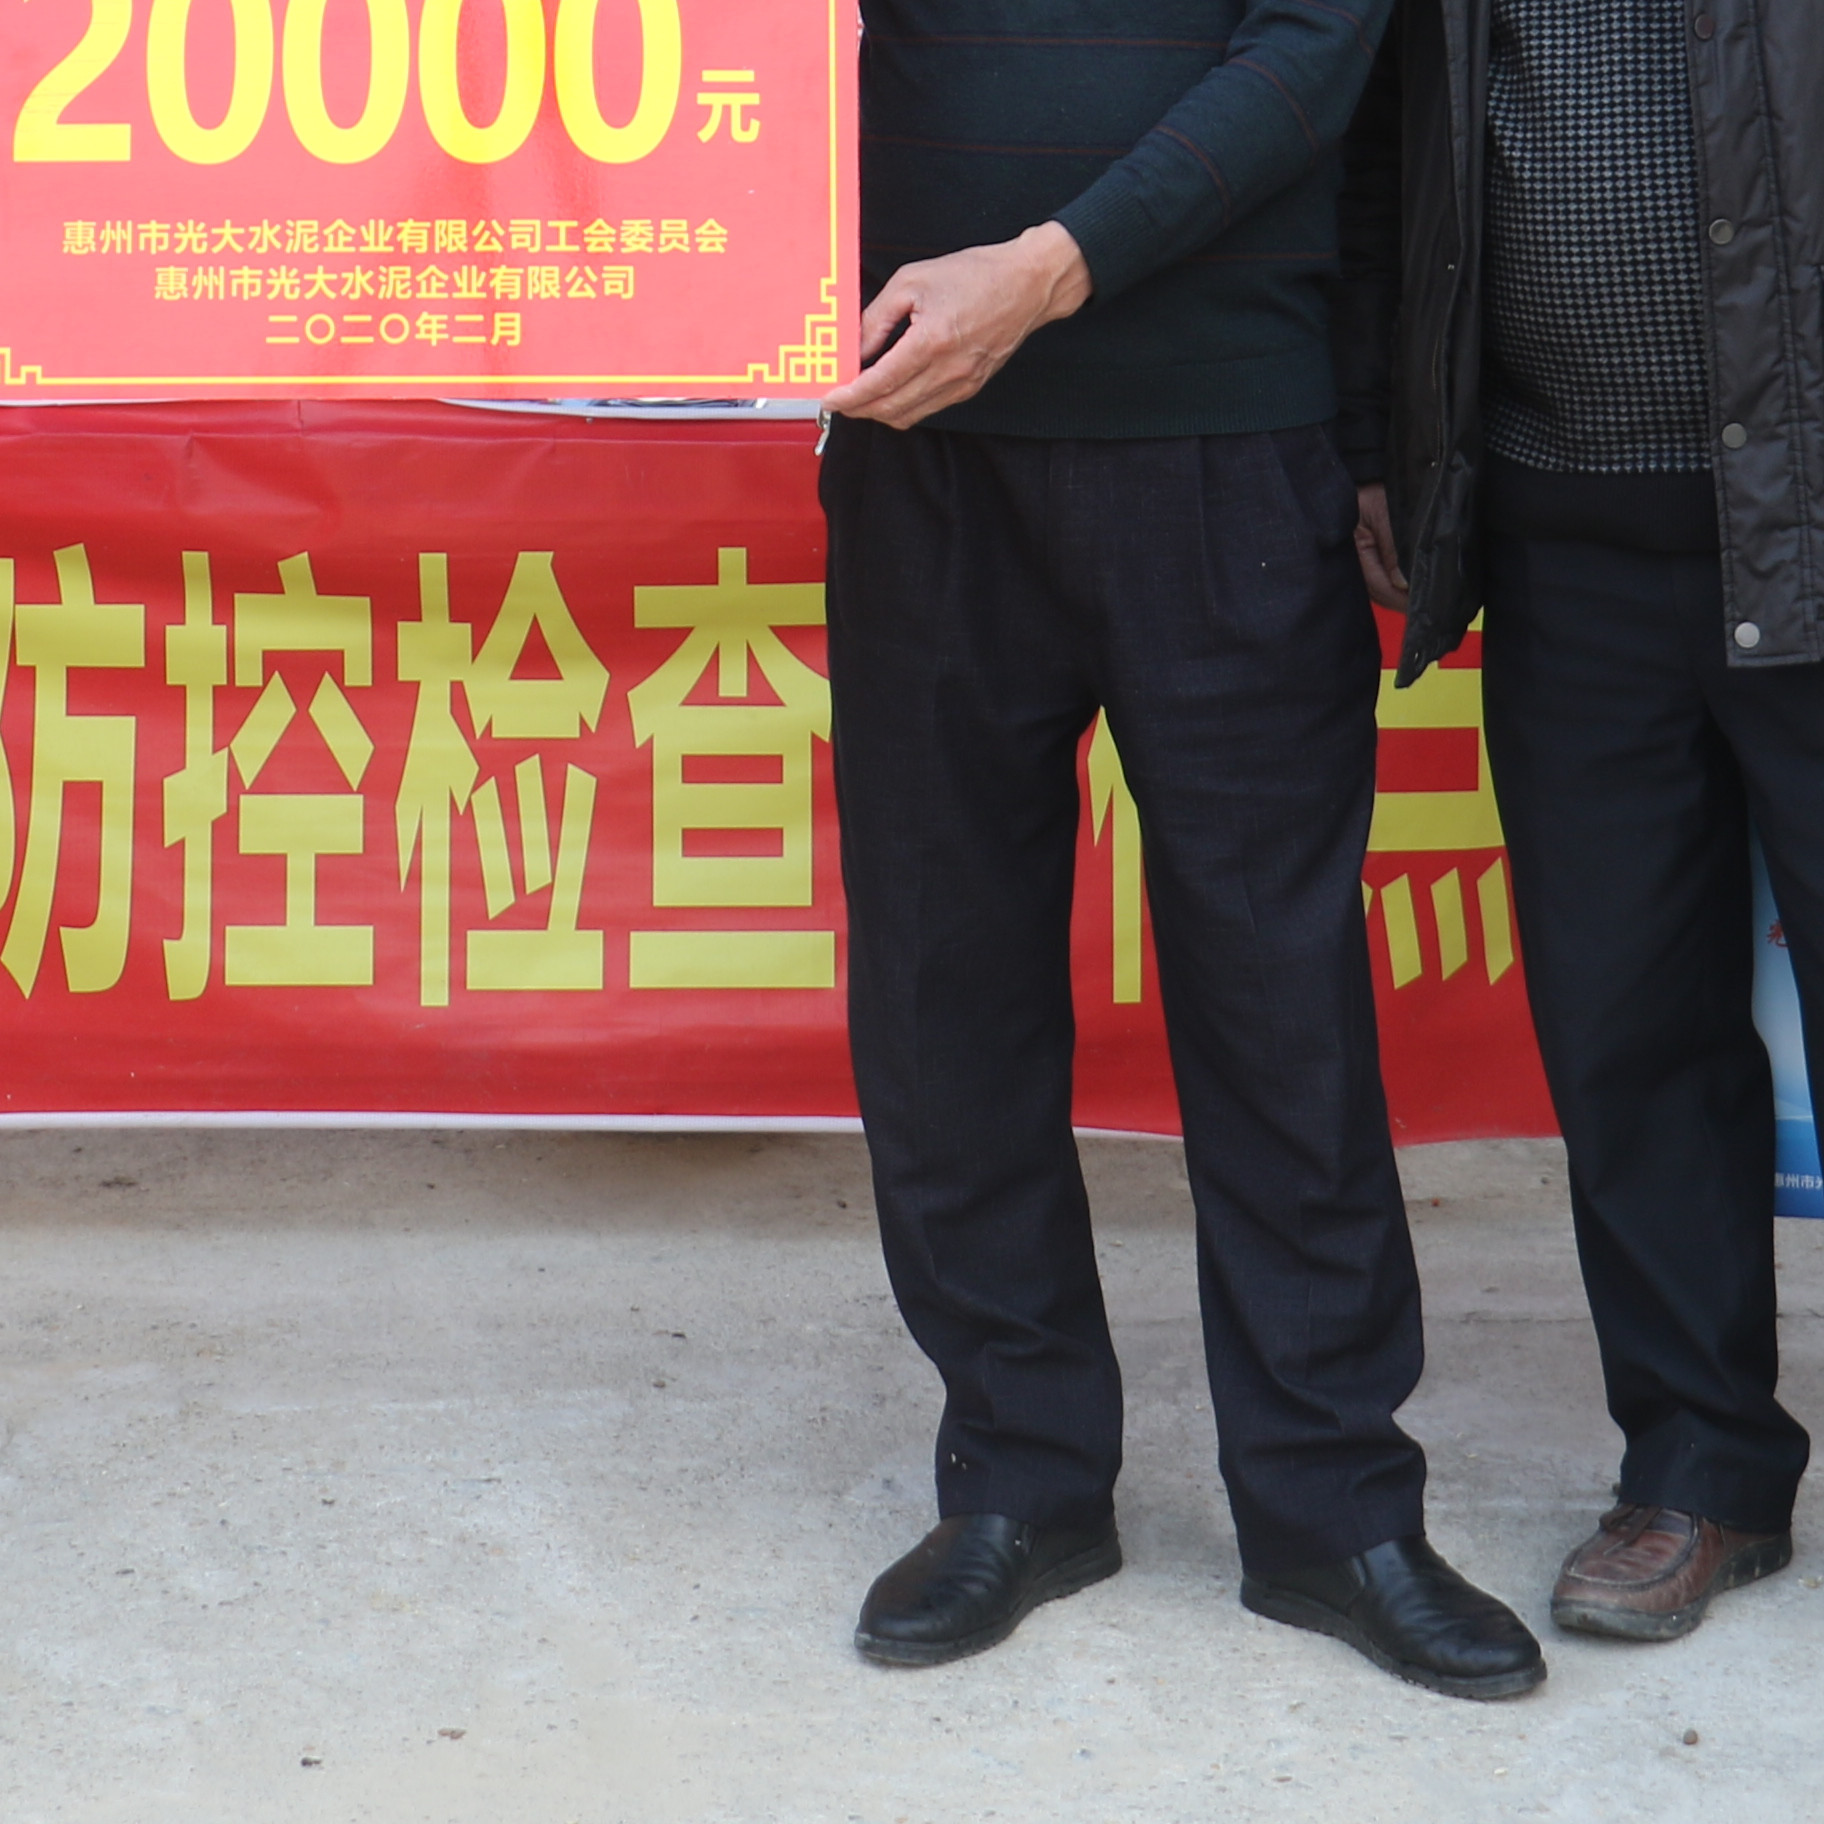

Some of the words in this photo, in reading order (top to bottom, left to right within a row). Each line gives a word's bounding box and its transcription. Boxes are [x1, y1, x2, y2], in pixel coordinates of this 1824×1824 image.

[696, 68, 762, 144] 元
[63, 218, 729, 256] 惠州市光大水泥企业有限公司工会委员会
[154, 265, 636, 302] 惠州市光大水泥企业有限公司
